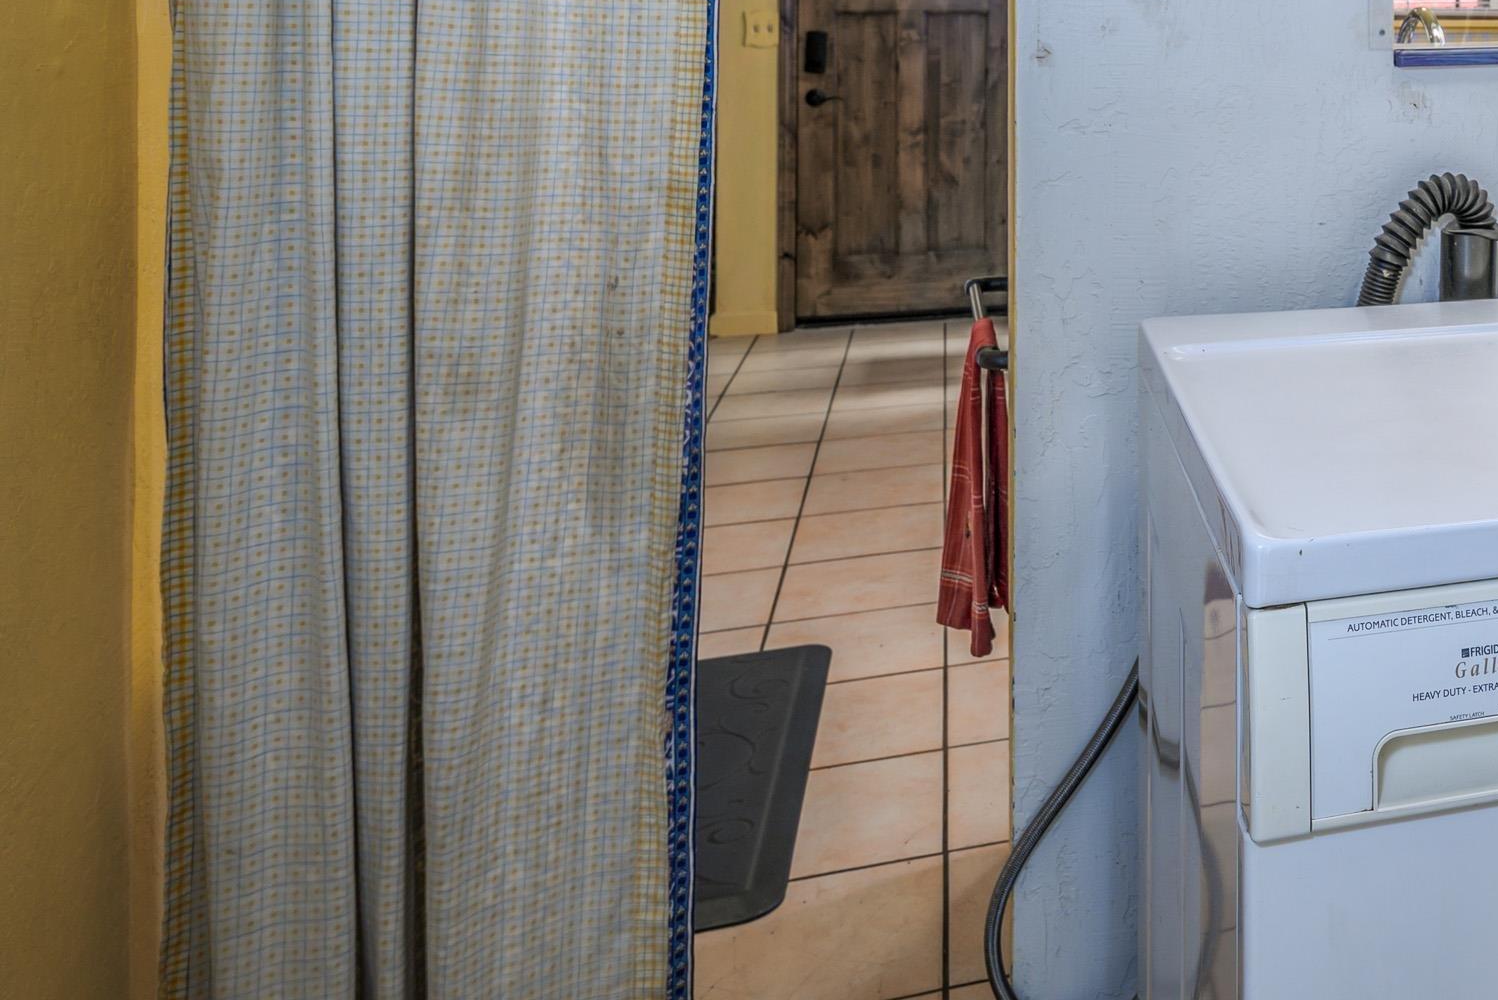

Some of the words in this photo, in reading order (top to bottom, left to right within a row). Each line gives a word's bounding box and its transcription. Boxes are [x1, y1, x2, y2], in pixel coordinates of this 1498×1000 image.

[1347, 618, 1399, 632] AUTOMATIC
[1400, 611, 1453, 626] DETERGENT,
[1455, 607, 1490, 619] BLEACH,
[1493, 606, 1498, 614] &
[1412, 690, 1441, 702] HEAVY
[1443, 686, 1467, 698] DUTY
